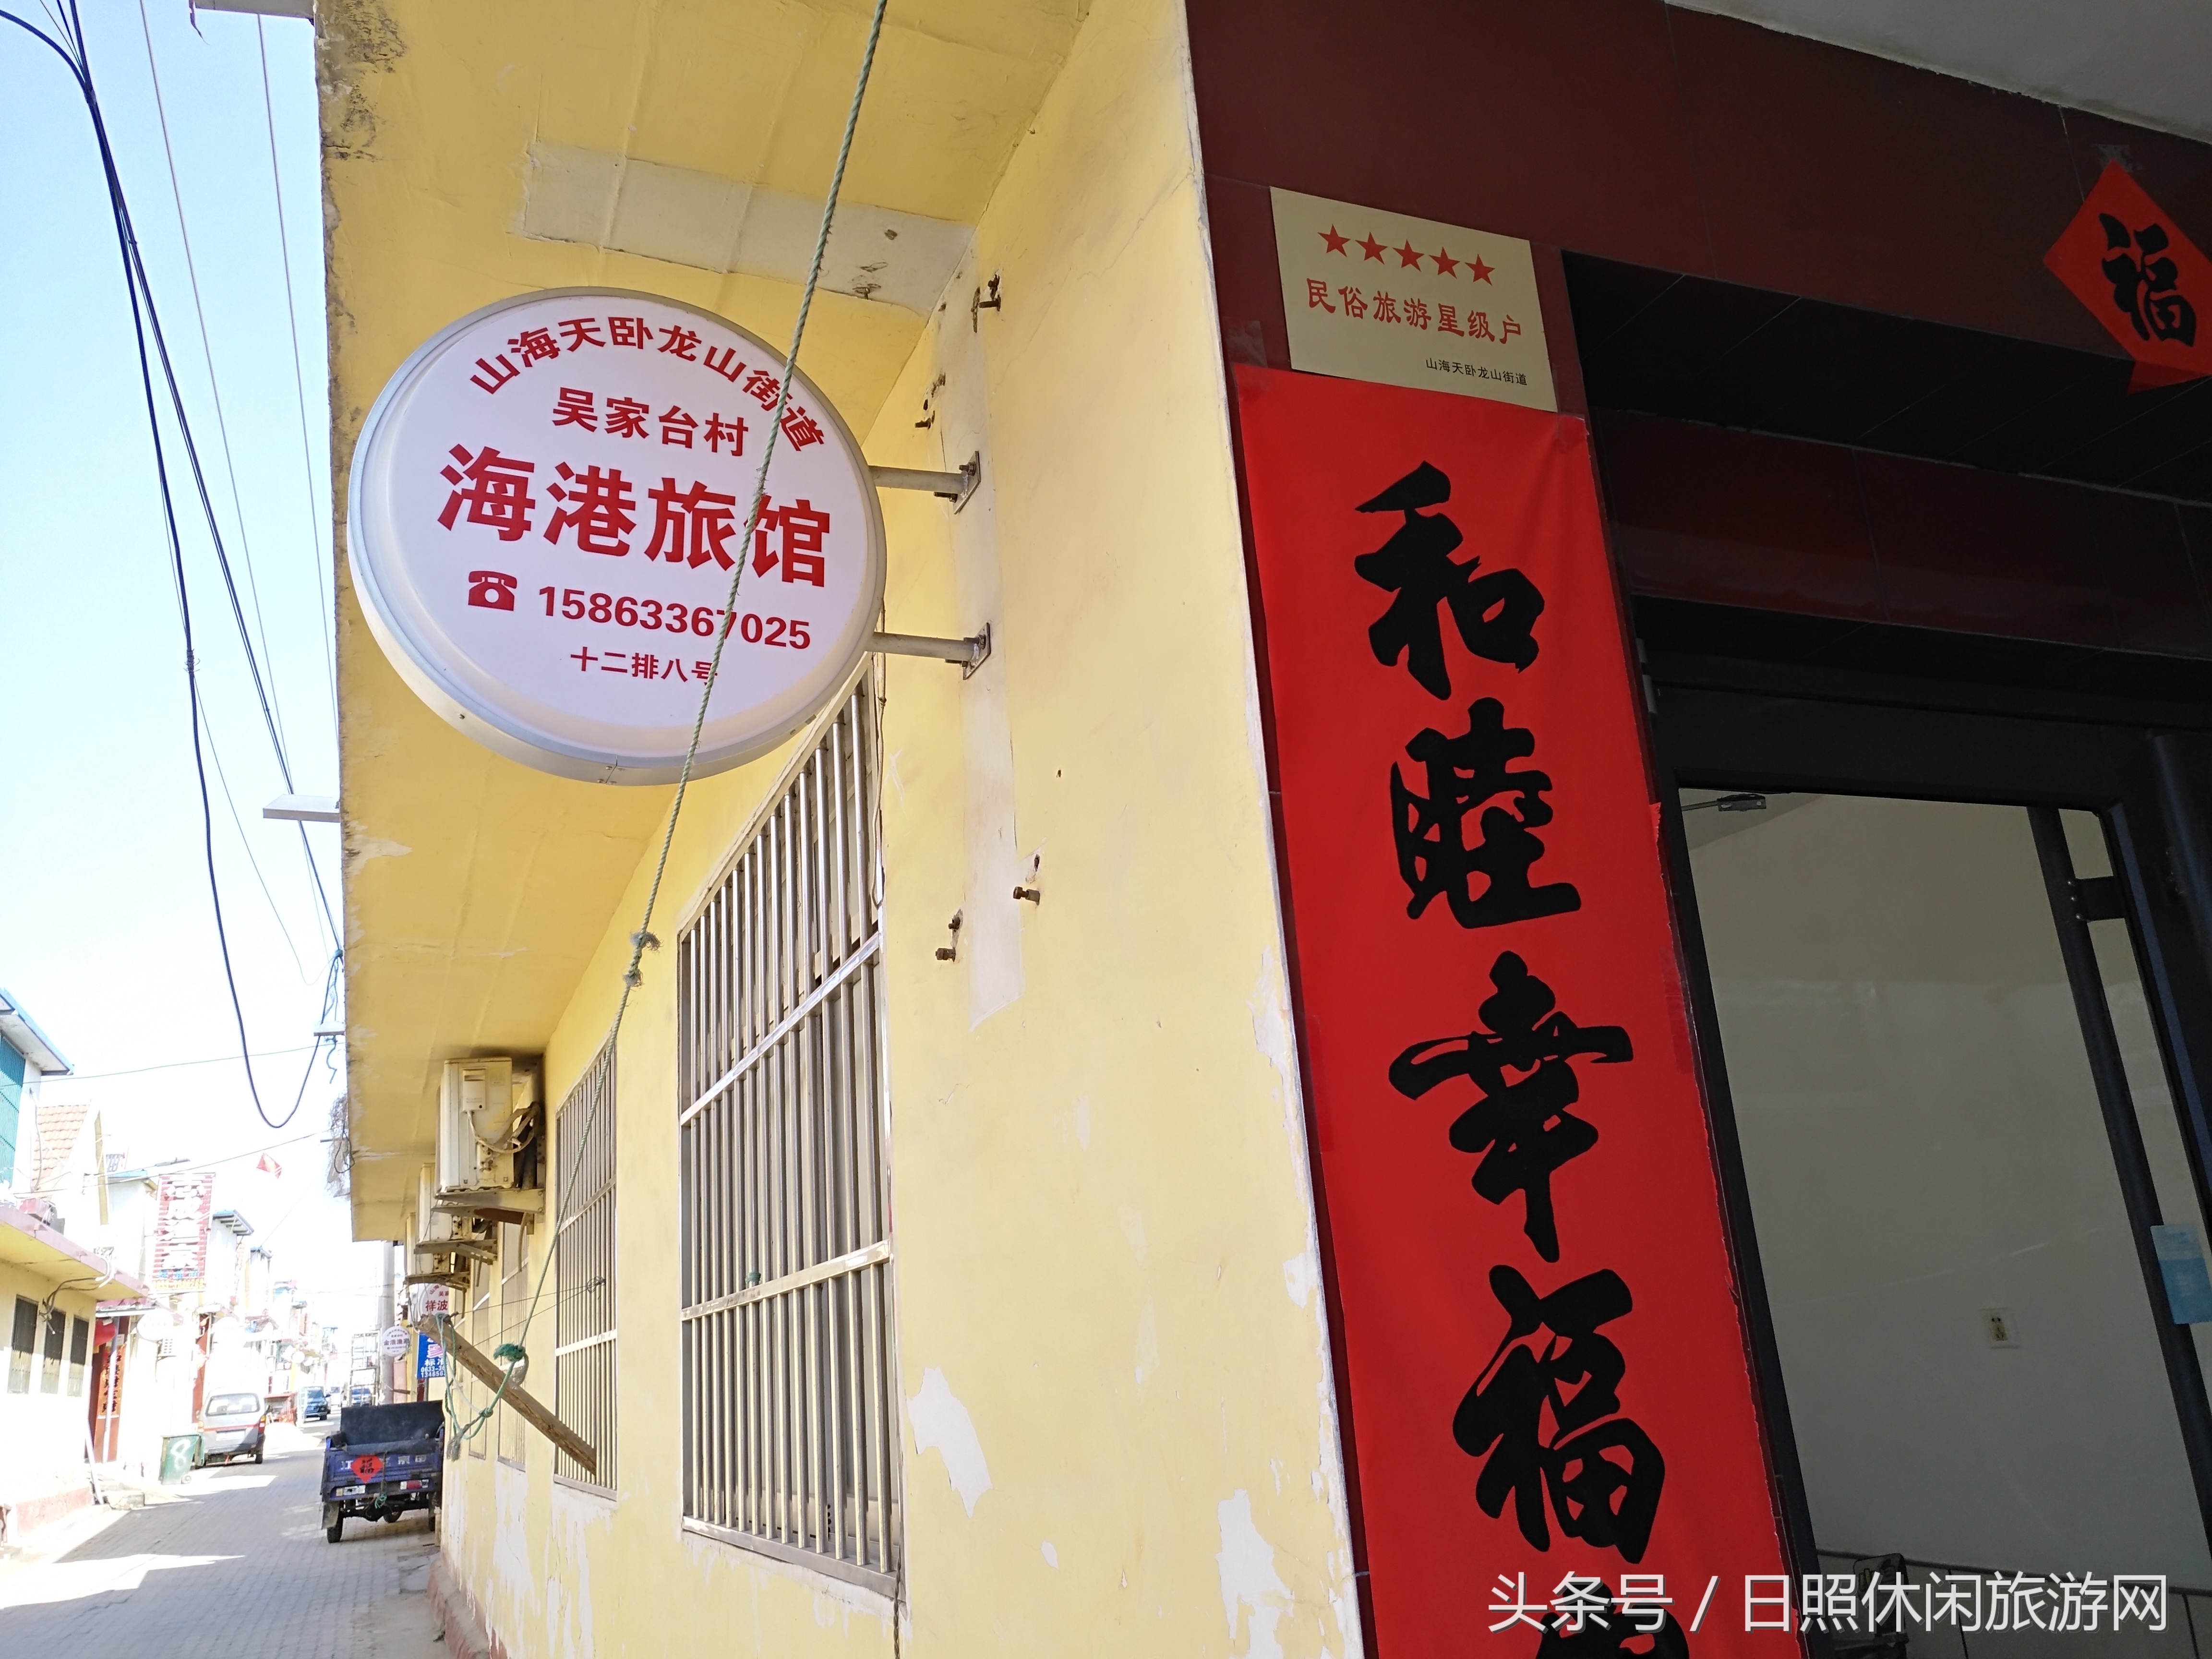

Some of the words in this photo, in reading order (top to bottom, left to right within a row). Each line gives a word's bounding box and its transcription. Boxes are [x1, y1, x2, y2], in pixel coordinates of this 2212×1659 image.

[1306, 277, 1522, 344] 民俗旅游星级户
[2098, 213, 2197, 348] 福
[469, 315, 825, 452] 山海天卧龙山街道
[1425, 357, 1527, 385] 山海天卧龙山街道
[553, 386, 749, 457] 吴家台村
[437, 443, 831, 588] 海港旅馆
[538, 585, 812, 649] 15863367025
[570, 645, 719, 685] 十二排八号
[360, 1457, 375, 1473] 福
